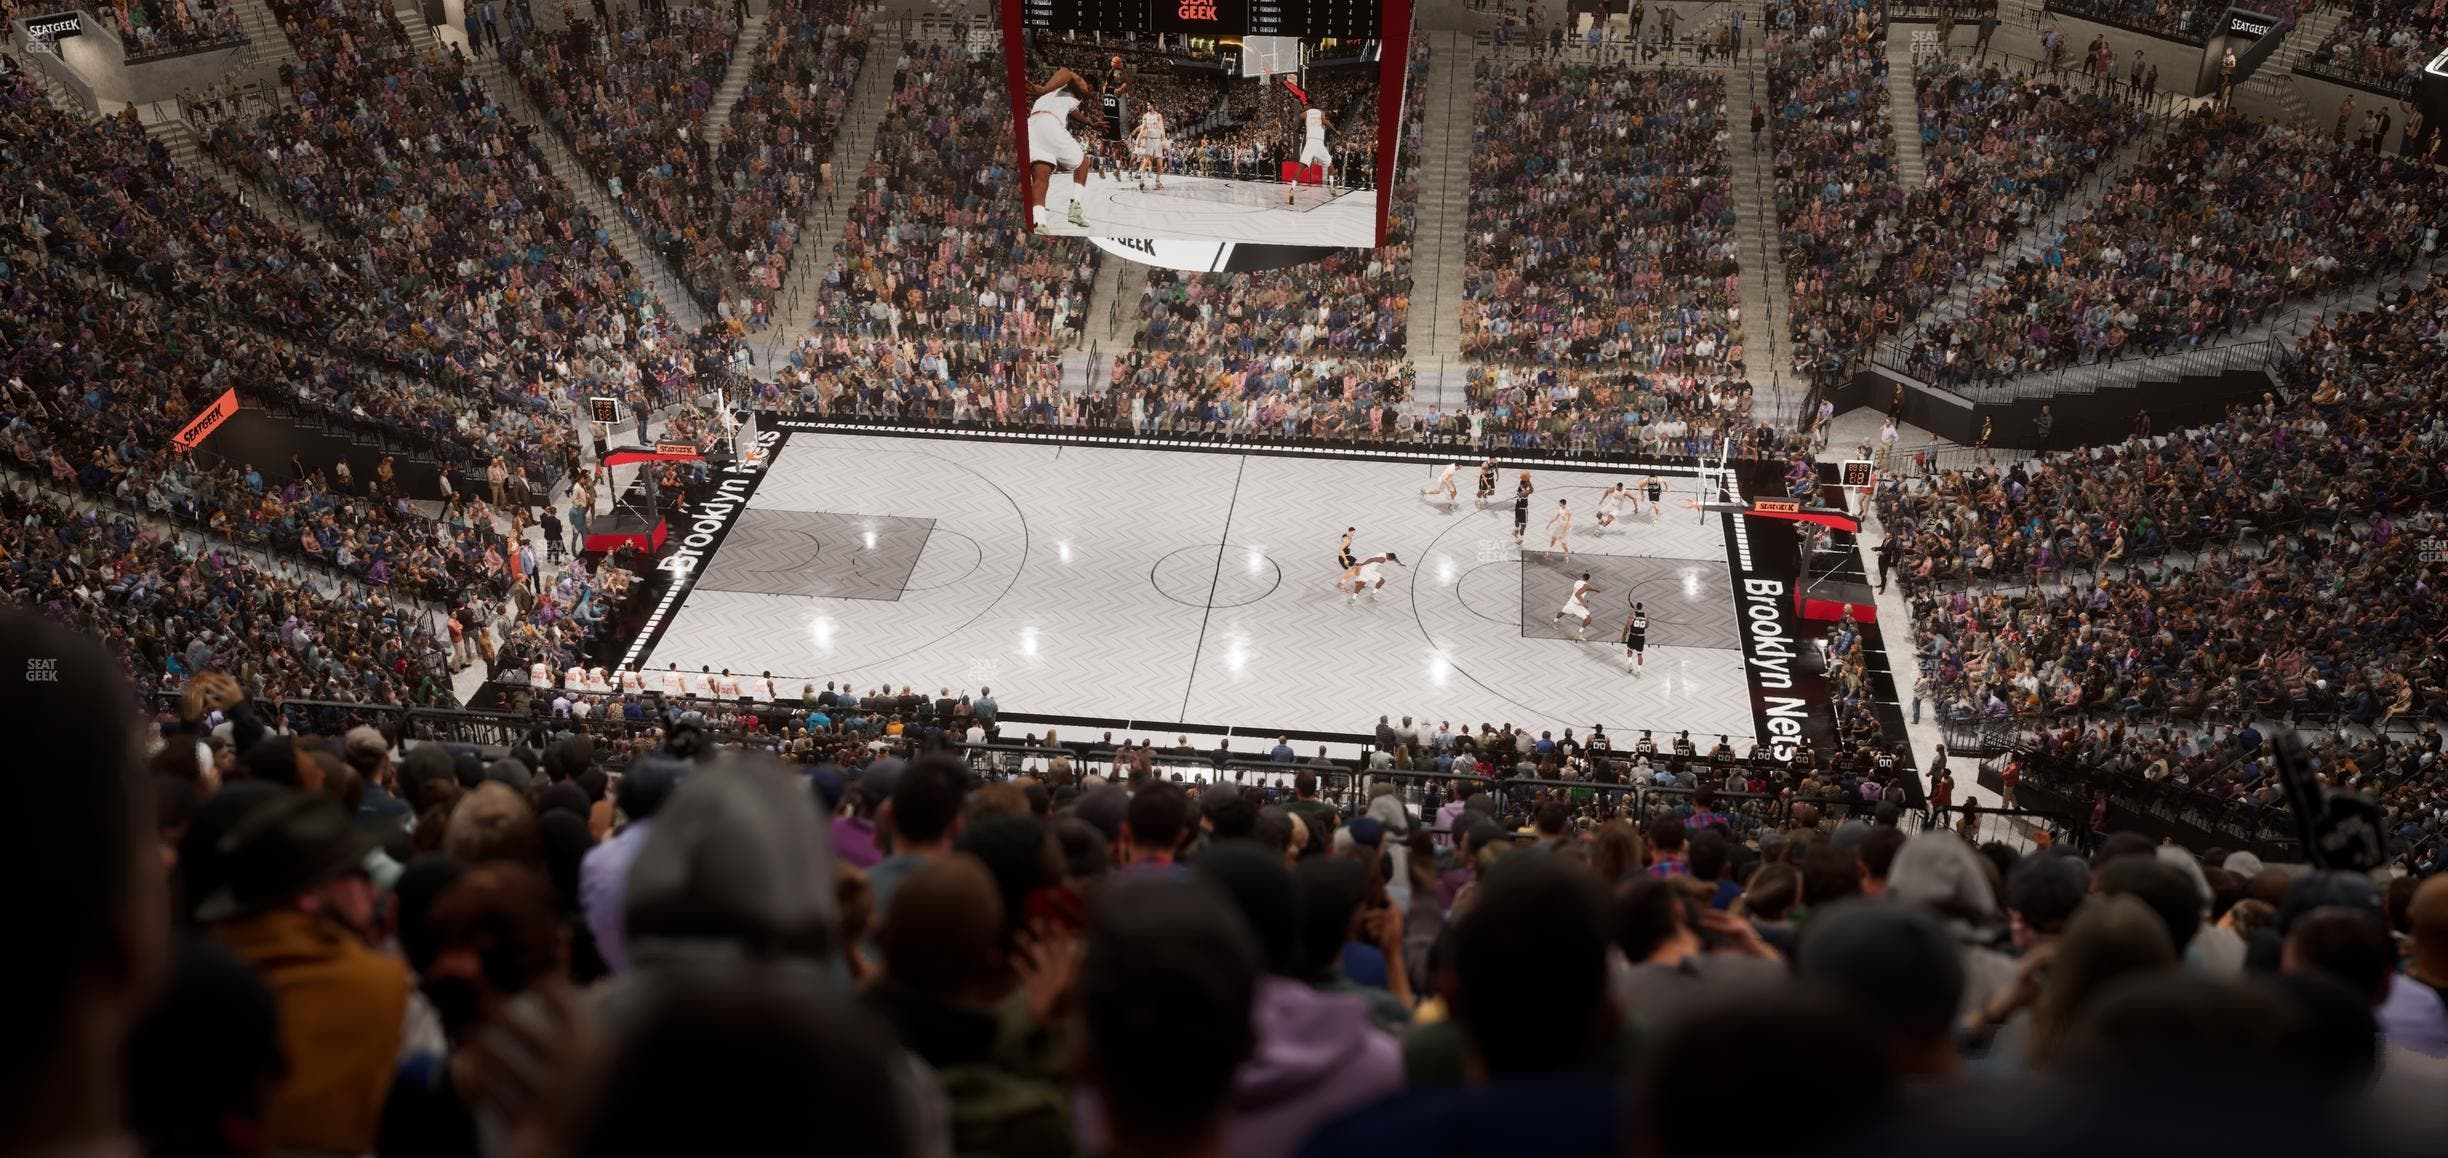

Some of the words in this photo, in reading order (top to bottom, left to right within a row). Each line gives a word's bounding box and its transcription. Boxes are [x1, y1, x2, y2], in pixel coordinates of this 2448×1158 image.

[29, 18, 80, 36] SEATGEEK
[1178, 5, 1218, 21] GEEK
[2231, 18, 2270, 36] SEATGEEK
[184, 403, 223, 446] SEATGEEK
[656, 479, 749, 572] Brooklyn
[1743, 578, 1797, 688] Brooklyn
[1763, 696, 1811, 762] Nets
[1878, 758, 1893, 768] 00
